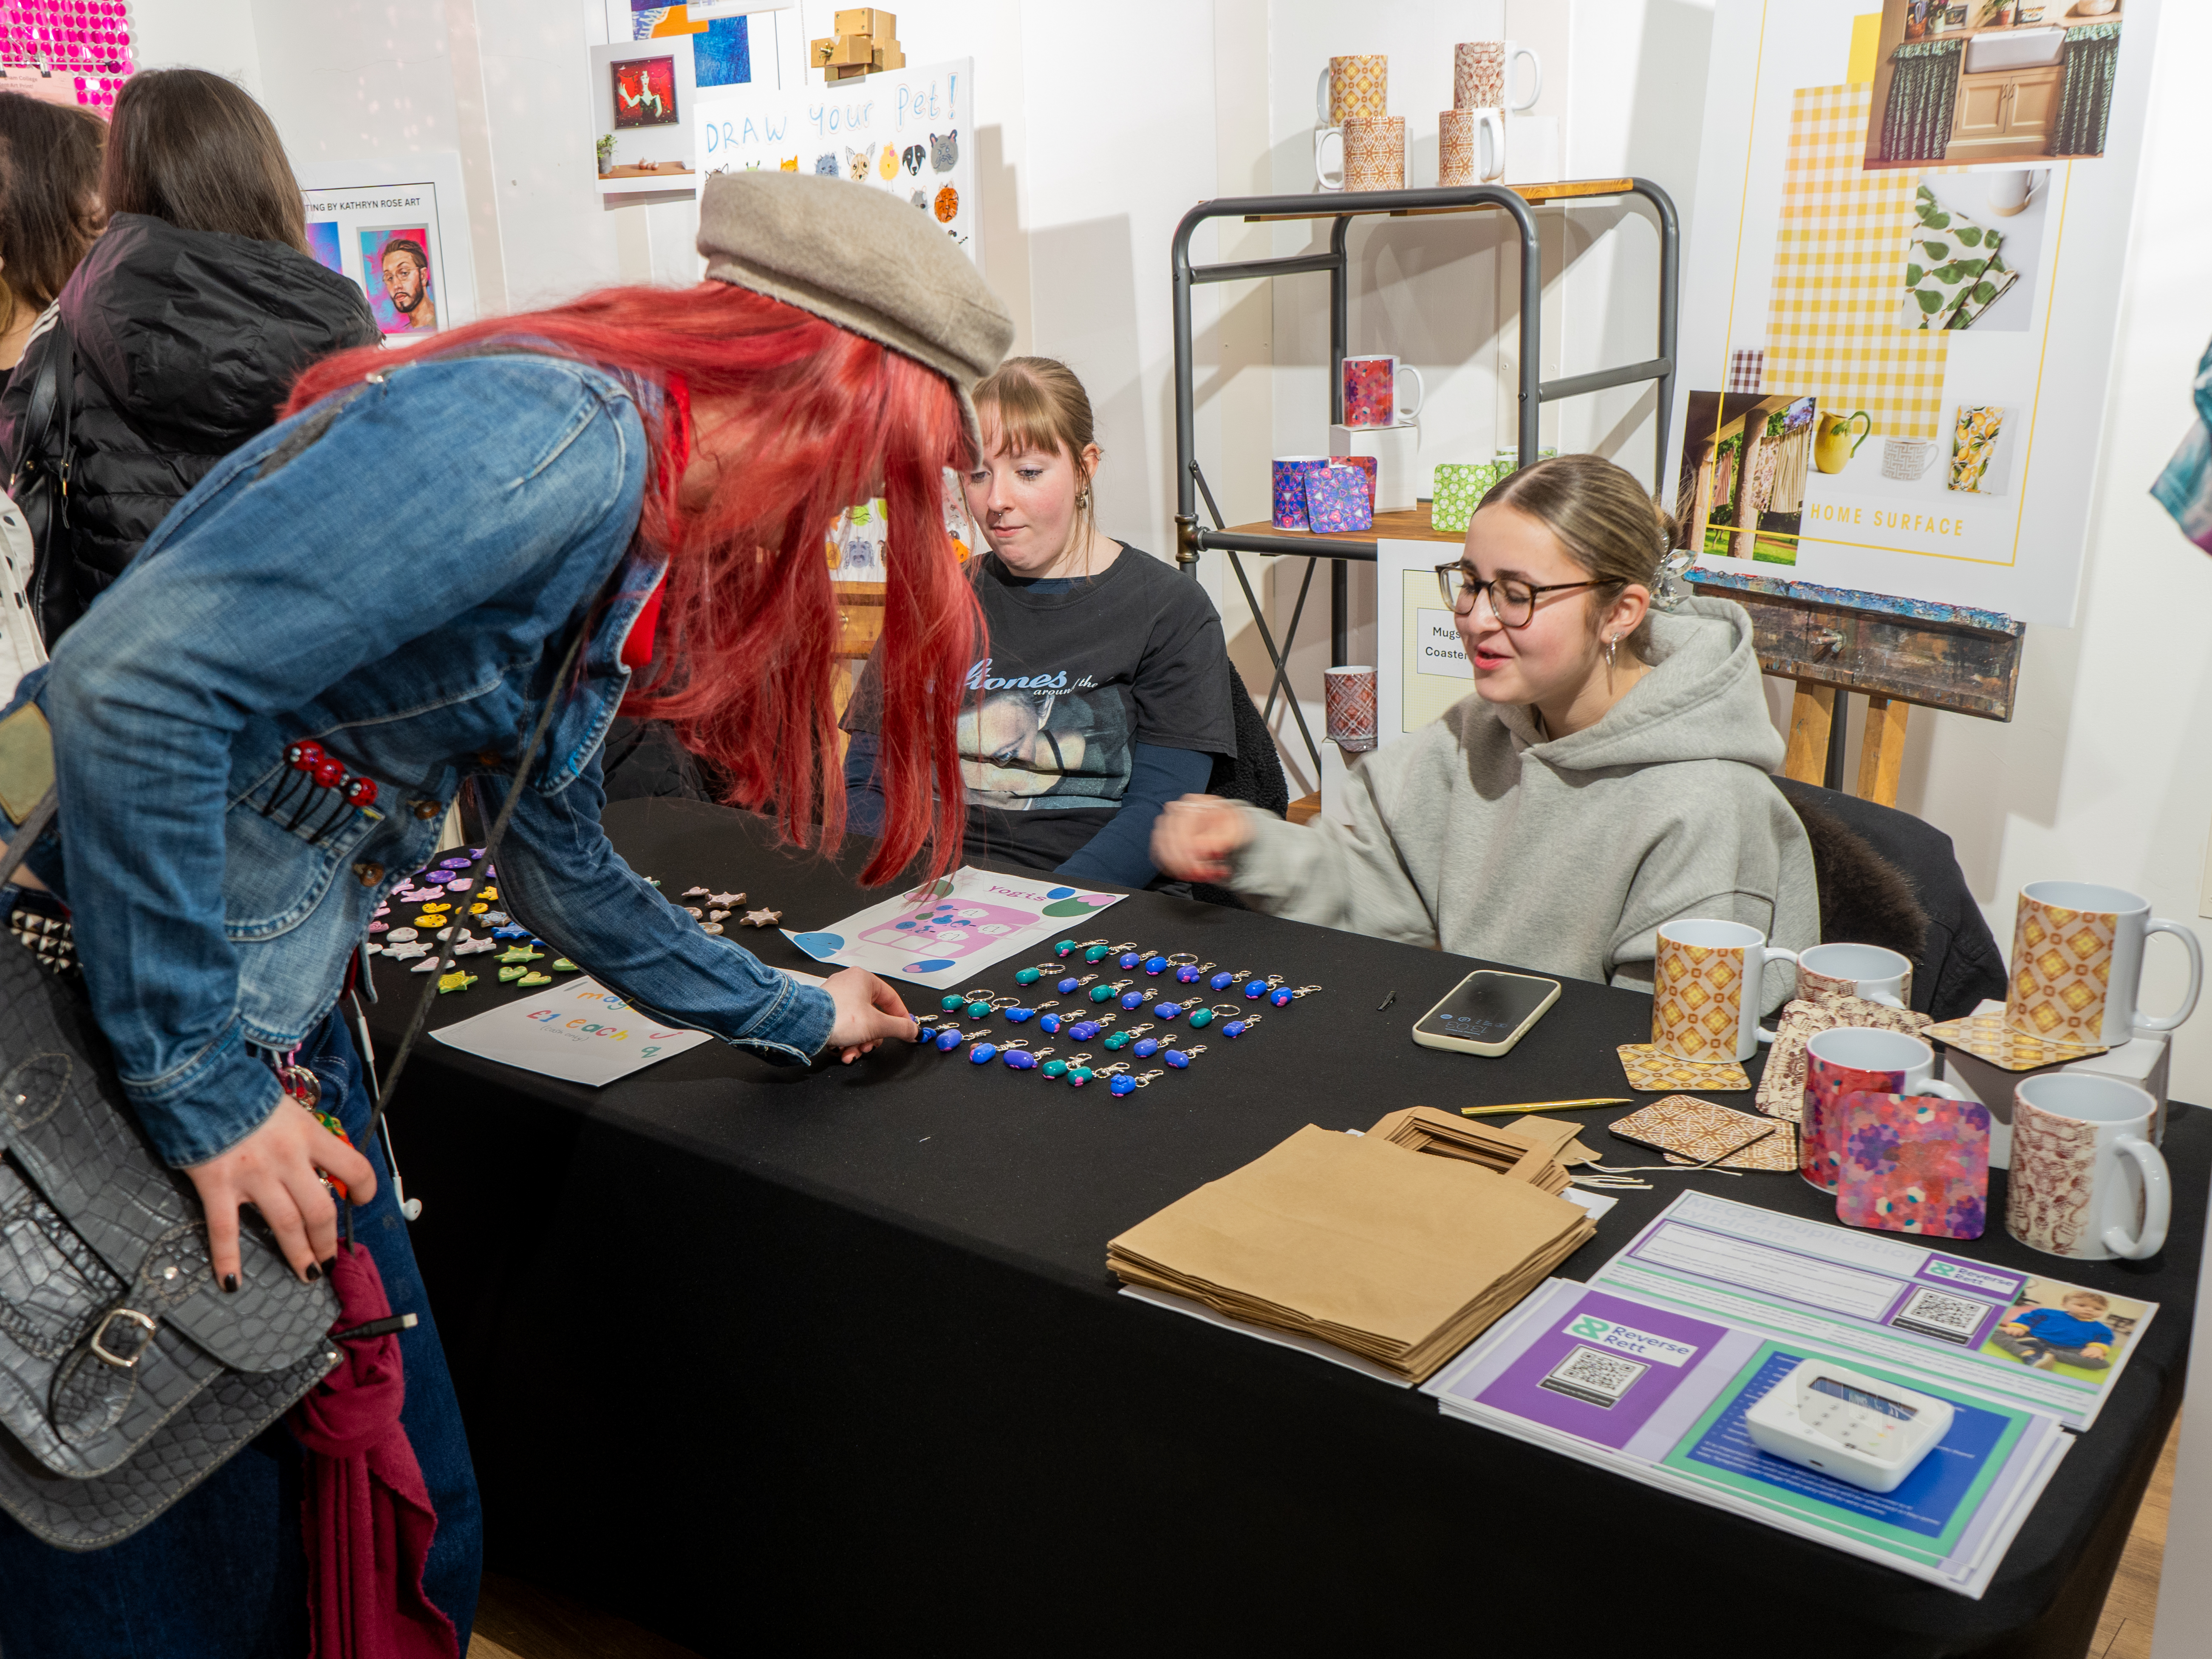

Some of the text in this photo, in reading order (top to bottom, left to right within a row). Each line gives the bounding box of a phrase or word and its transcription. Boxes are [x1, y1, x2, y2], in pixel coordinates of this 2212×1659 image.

[705, 113, 788, 155] DRAW
[327, 203, 337, 211] BY
[340, 201, 378, 210] KATHRYN
[381, 199, 403, 208] ROSE
[405, 198, 421, 206] ART
[1810, 503, 1963, 537] HOME SURFACE
[1433, 627, 1461, 640] Mugs
[989, 885, 1047, 902] Yogis
[577, 992, 636, 1013] mag
[526, 1010, 629, 1041] £1 each
[540, 1025, 590, 1042] (cash only)
[1677, 1207, 1798, 1243] syndrome
[1687, 1196, 1771, 1224] MECP2
[1776, 1218, 1925, 1263] Duplication
[1955, 1274, 1983, 1285] Rett
[1957, 1268, 2014, 1286] Reverse
[1603, 1334, 1646, 1353] Rett
[1612, 1326, 1689, 1354] Reverse
